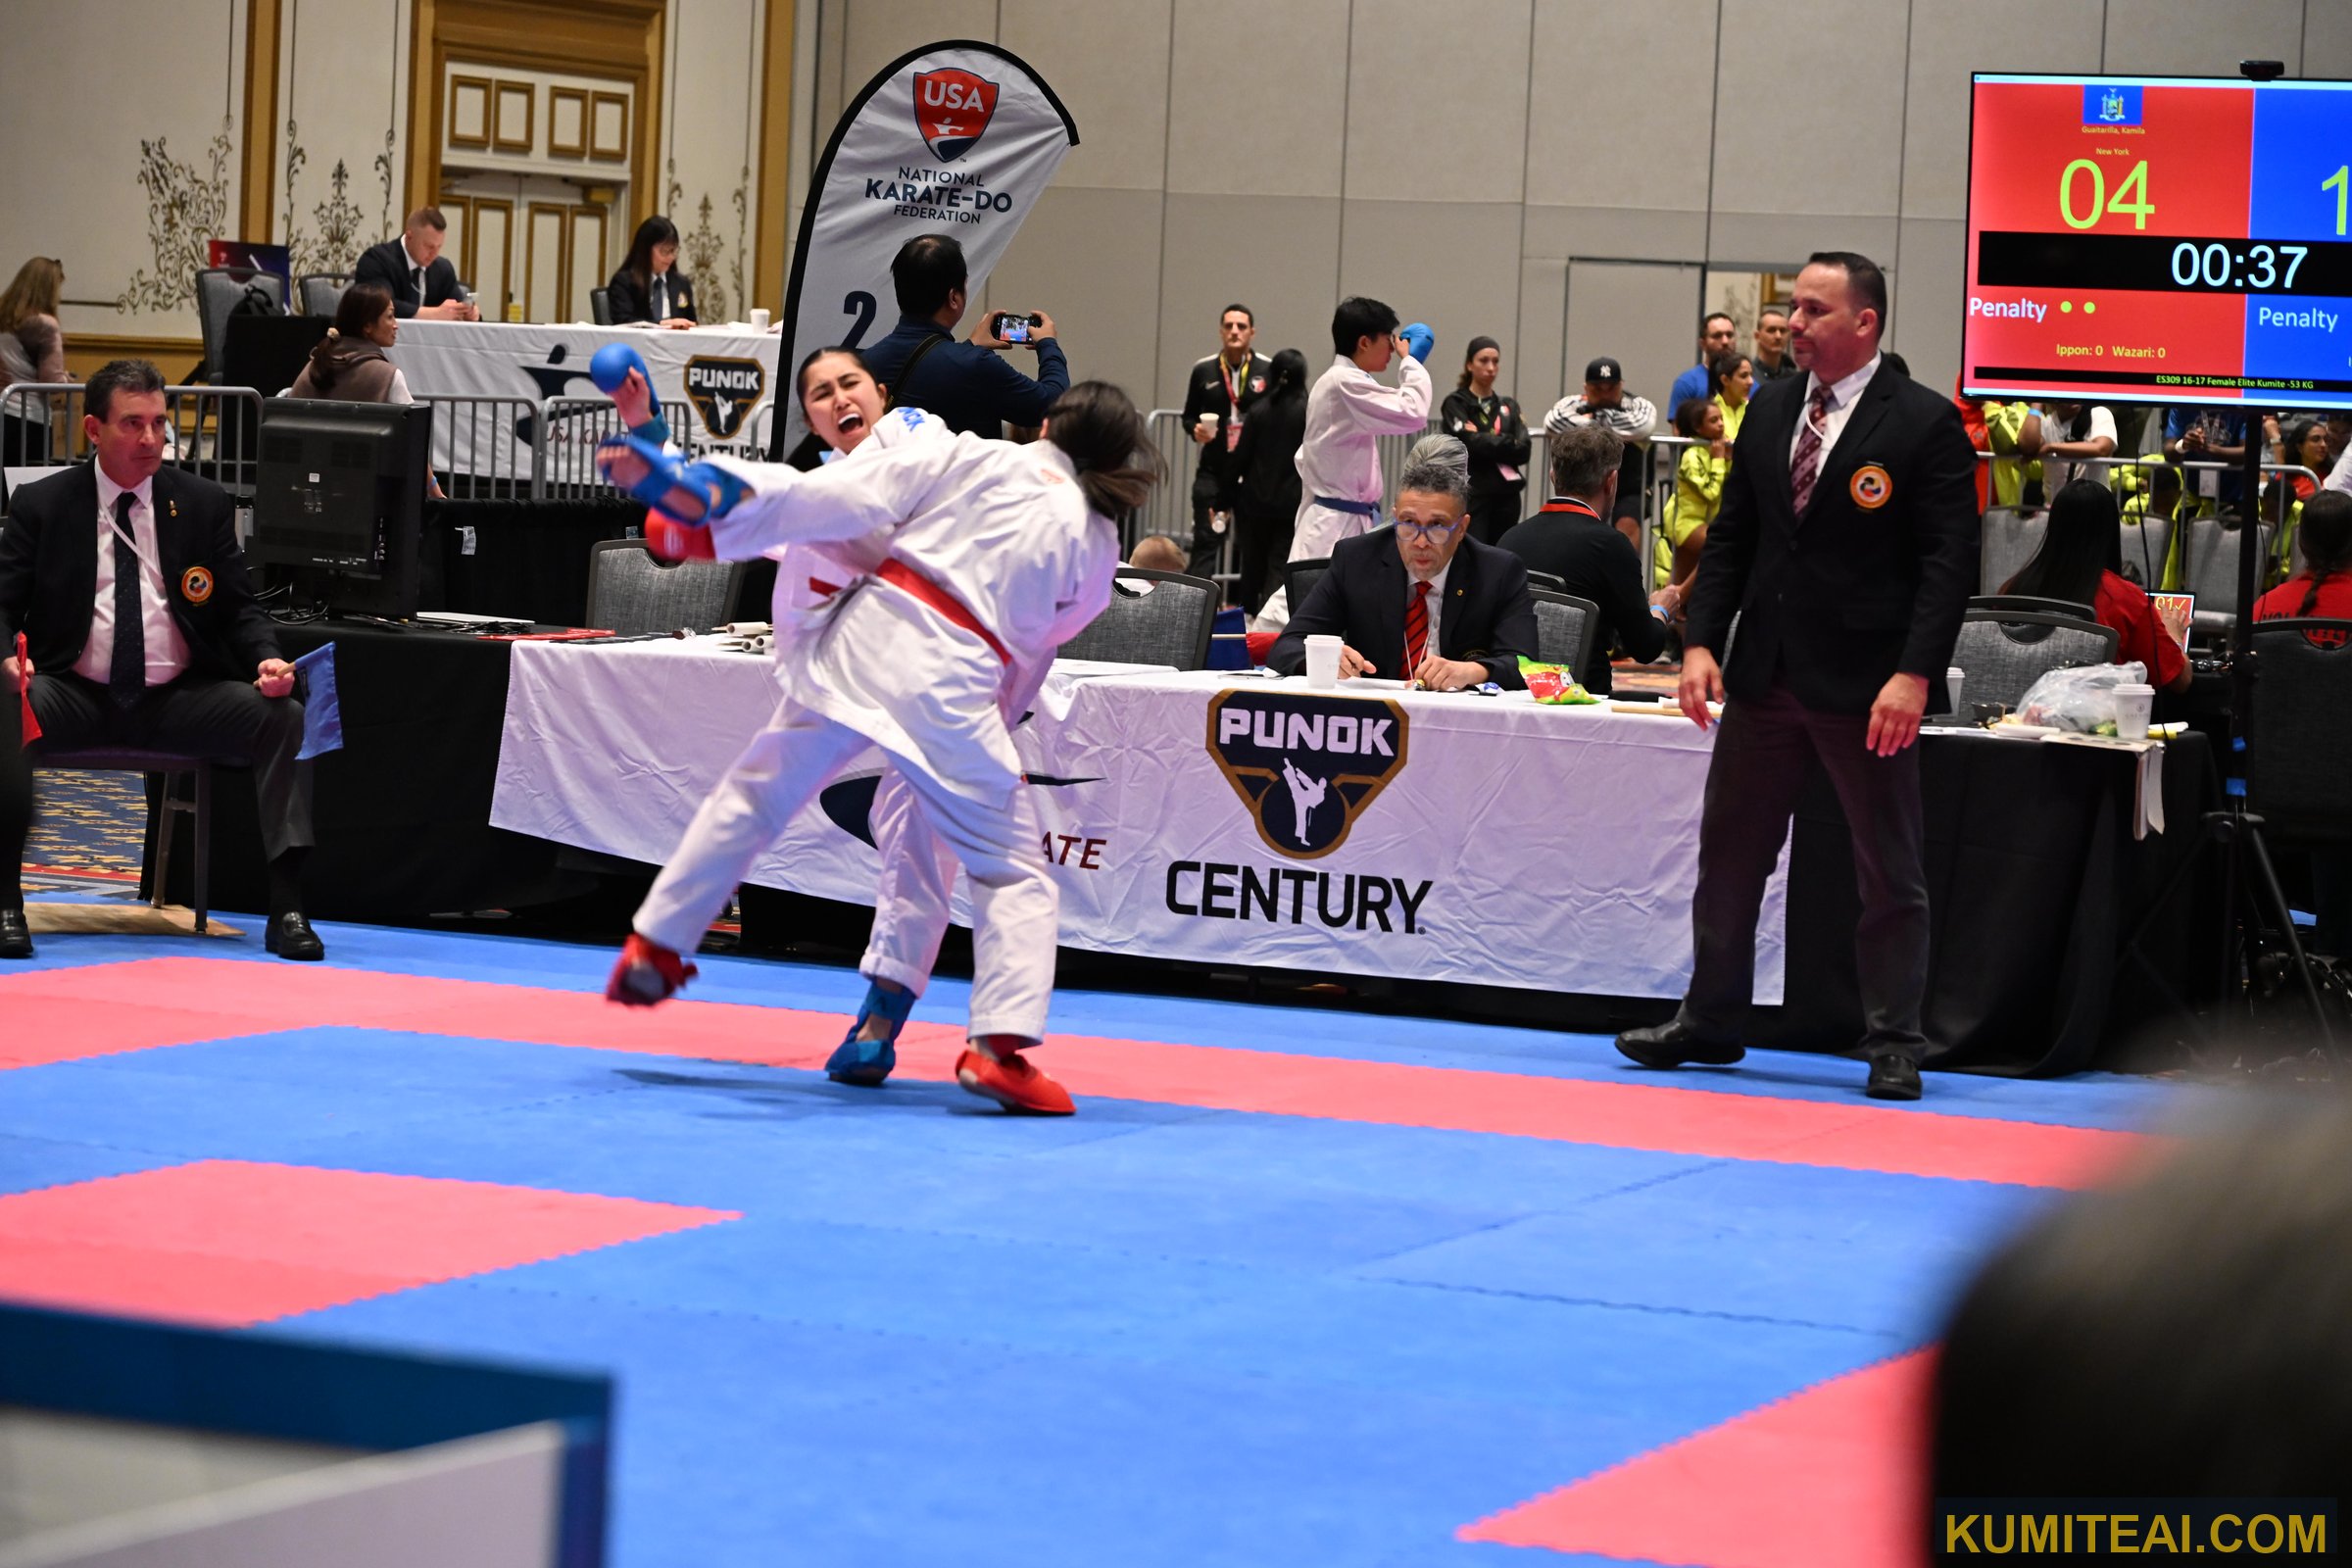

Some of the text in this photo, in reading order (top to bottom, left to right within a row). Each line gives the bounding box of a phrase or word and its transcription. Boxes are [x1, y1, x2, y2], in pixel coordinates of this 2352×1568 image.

[923, 80, 984, 113] USA
[898, 166, 984, 187] NATIONAL
[864, 178, 1012, 213] KARATE-DO
[2060, 159, 2155, 229] 04
[893, 204, 981, 224] FEDERATION
[2172, 242, 2308, 288] 00:37
[841, 290, 877, 349] 2
[1970, 297, 2047, 323] Penalty
[2259, 307, 2338, 333] Penalty
[2056, 344, 2103, 357] Ippon: 0
[2112, 345, 2166, 358] Wazari: 0
[688, 368, 760, 390] PUNOK
[2156, 374, 2181, 384] ES309
[2182, 376, 2206, 385] 16-17
[2207, 377, 2236, 386] Female
[2257, 378, 2285, 388] Kumite
[2302, 380, 2314, 389] KG
[2156, 596, 2174, 612] 01
[1219, 708, 1395, 757] PUNOK
[1042, 831, 1107, 870] ATE
[1166, 860, 1434, 934] CENTURY
